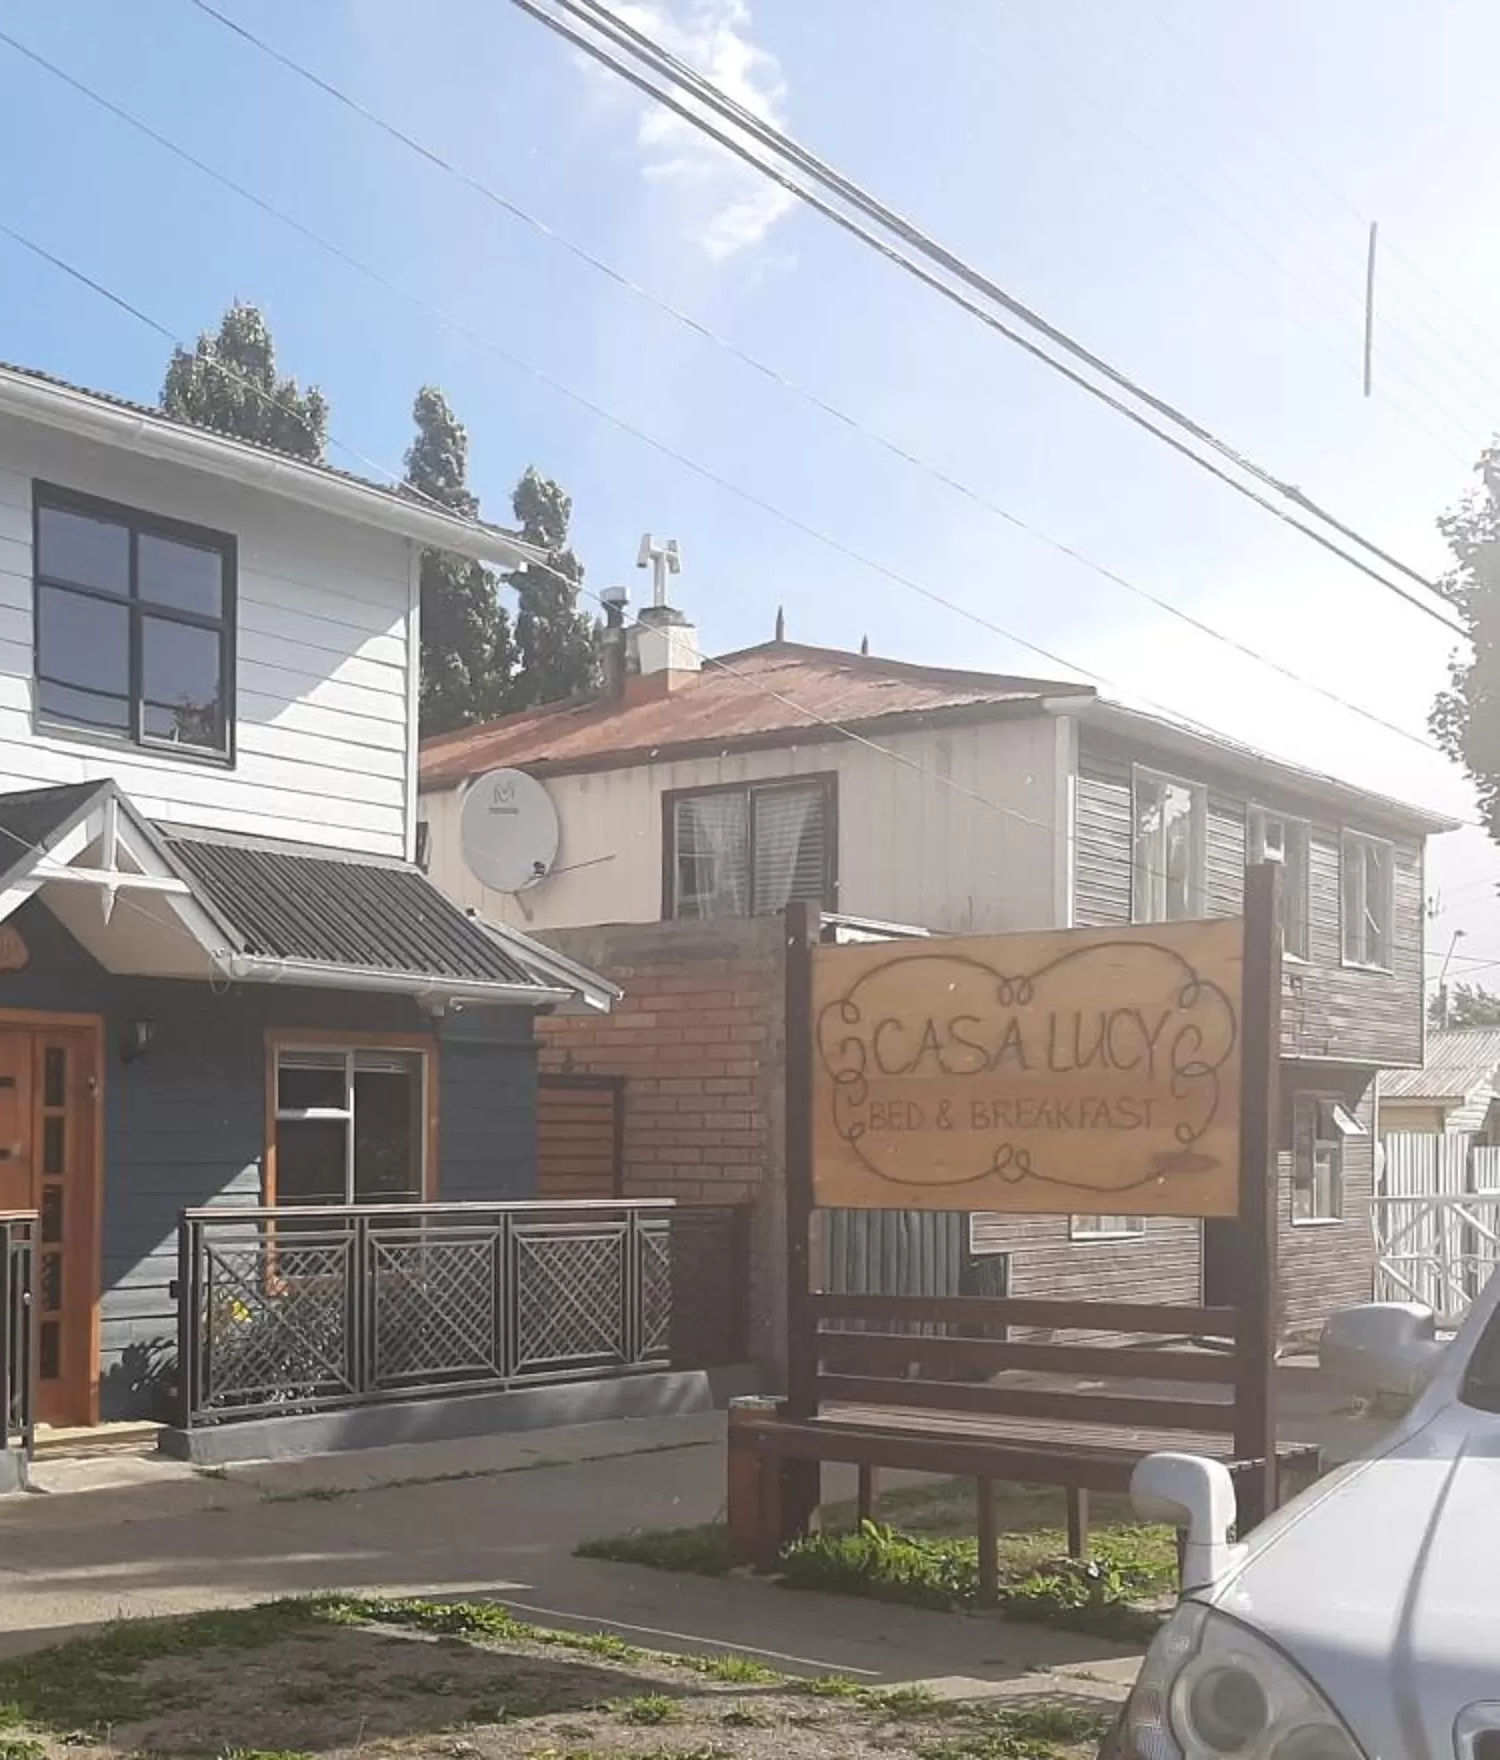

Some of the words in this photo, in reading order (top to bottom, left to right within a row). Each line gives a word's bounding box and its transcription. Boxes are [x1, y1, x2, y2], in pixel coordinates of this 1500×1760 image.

[872, 1014, 1033, 1076] CASA
[1047, 1006, 1173, 1079] LUCY
[867, 1100, 925, 1132] BED
[934, 1099, 956, 1131] &
[971, 1098, 1158, 1131] BREAKFAST
